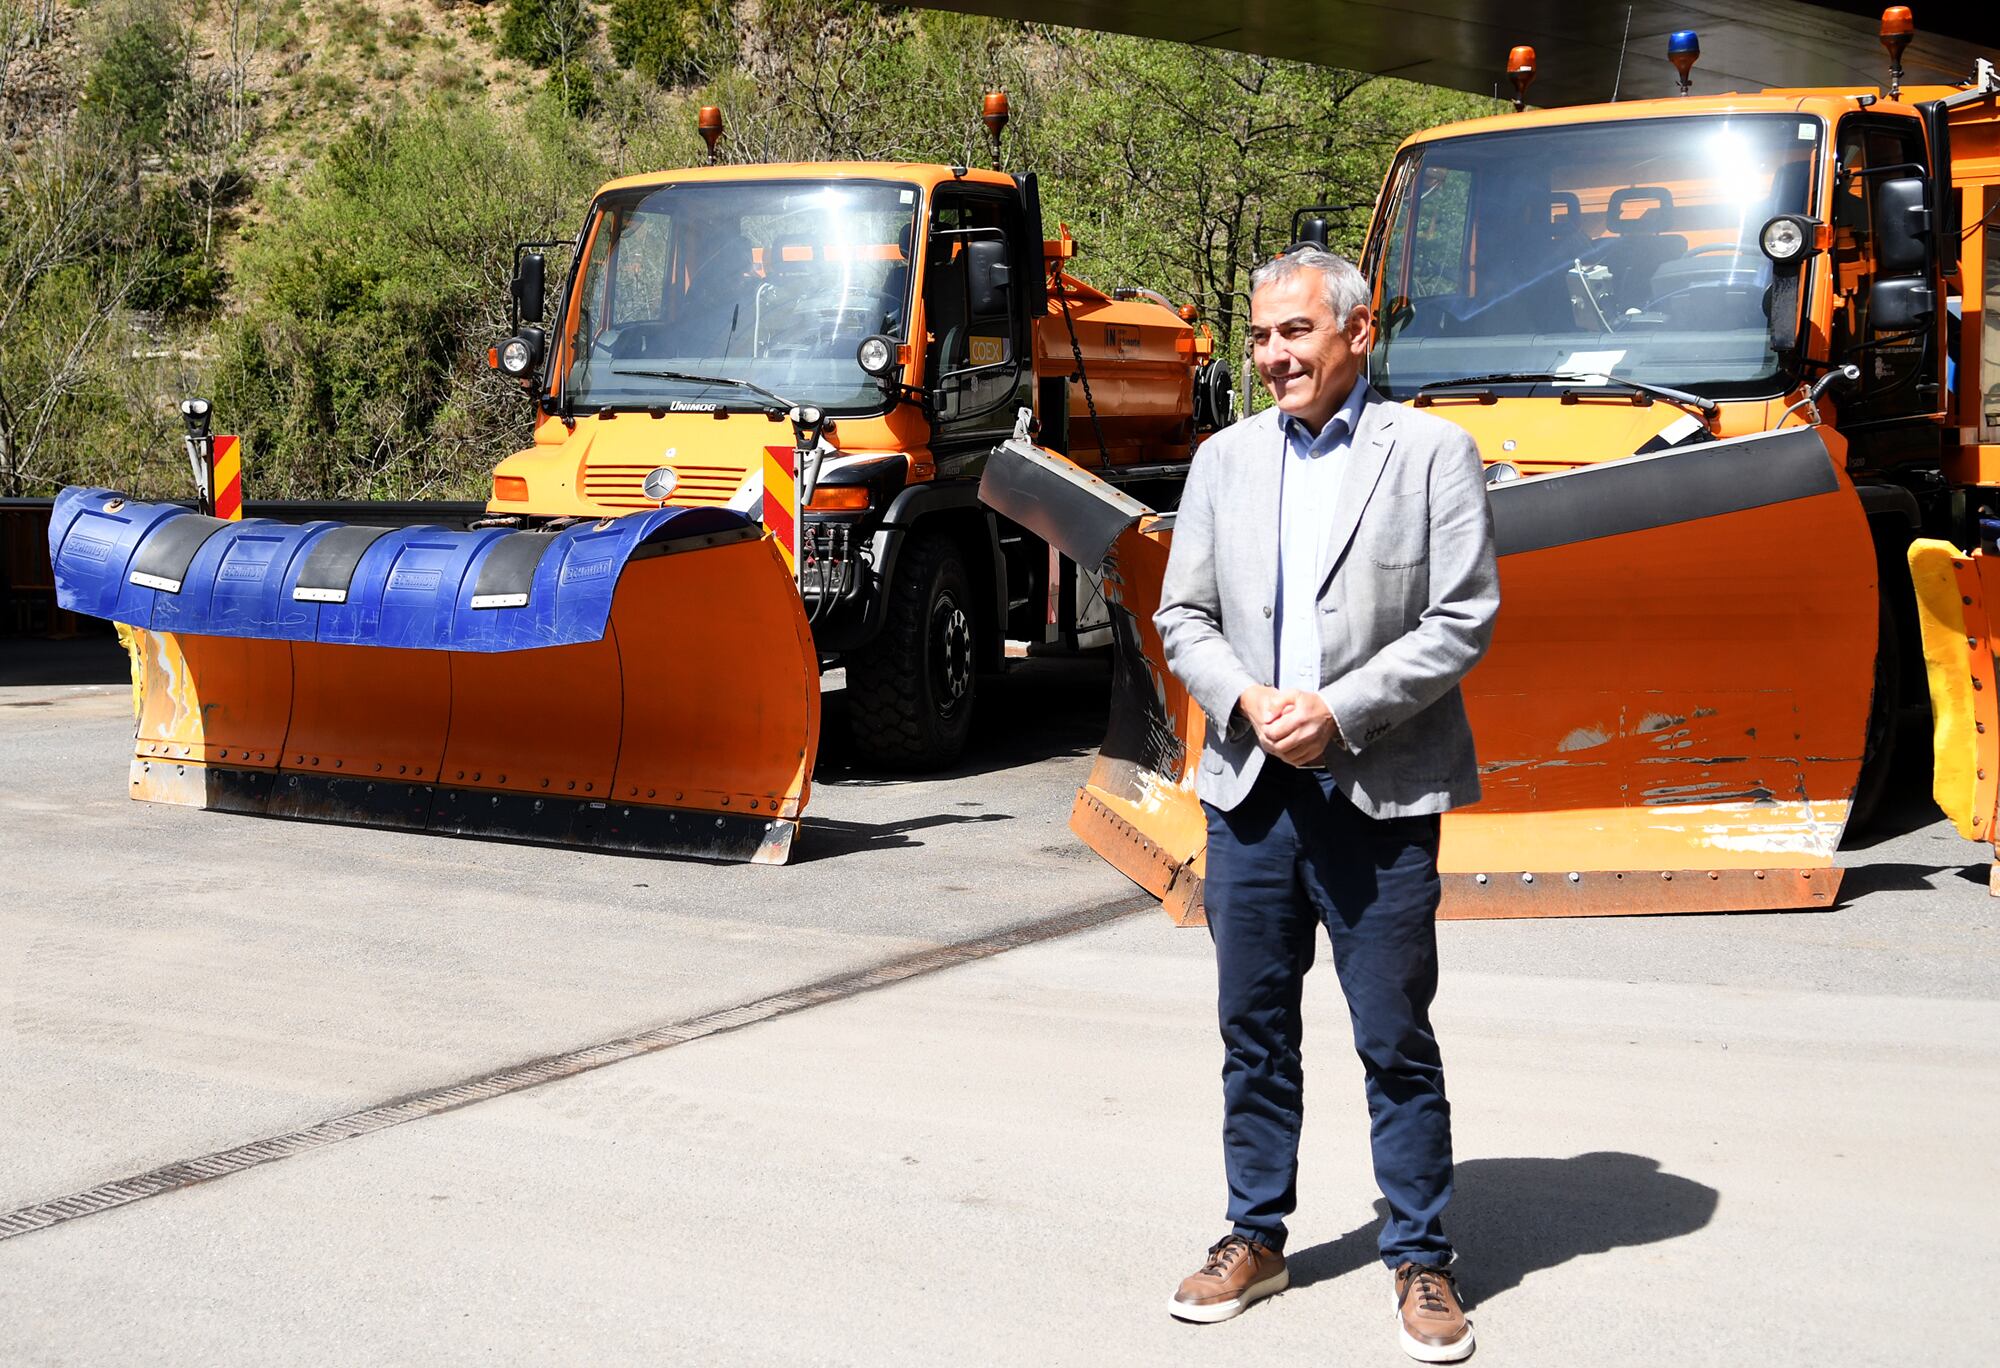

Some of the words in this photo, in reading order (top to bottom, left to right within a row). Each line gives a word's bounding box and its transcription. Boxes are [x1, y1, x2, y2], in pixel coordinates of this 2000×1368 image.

[973, 342, 1000, 361] COEX
[670, 400, 717, 411] UNIMOG
[67, 540, 108, 558] SCHMIDT
